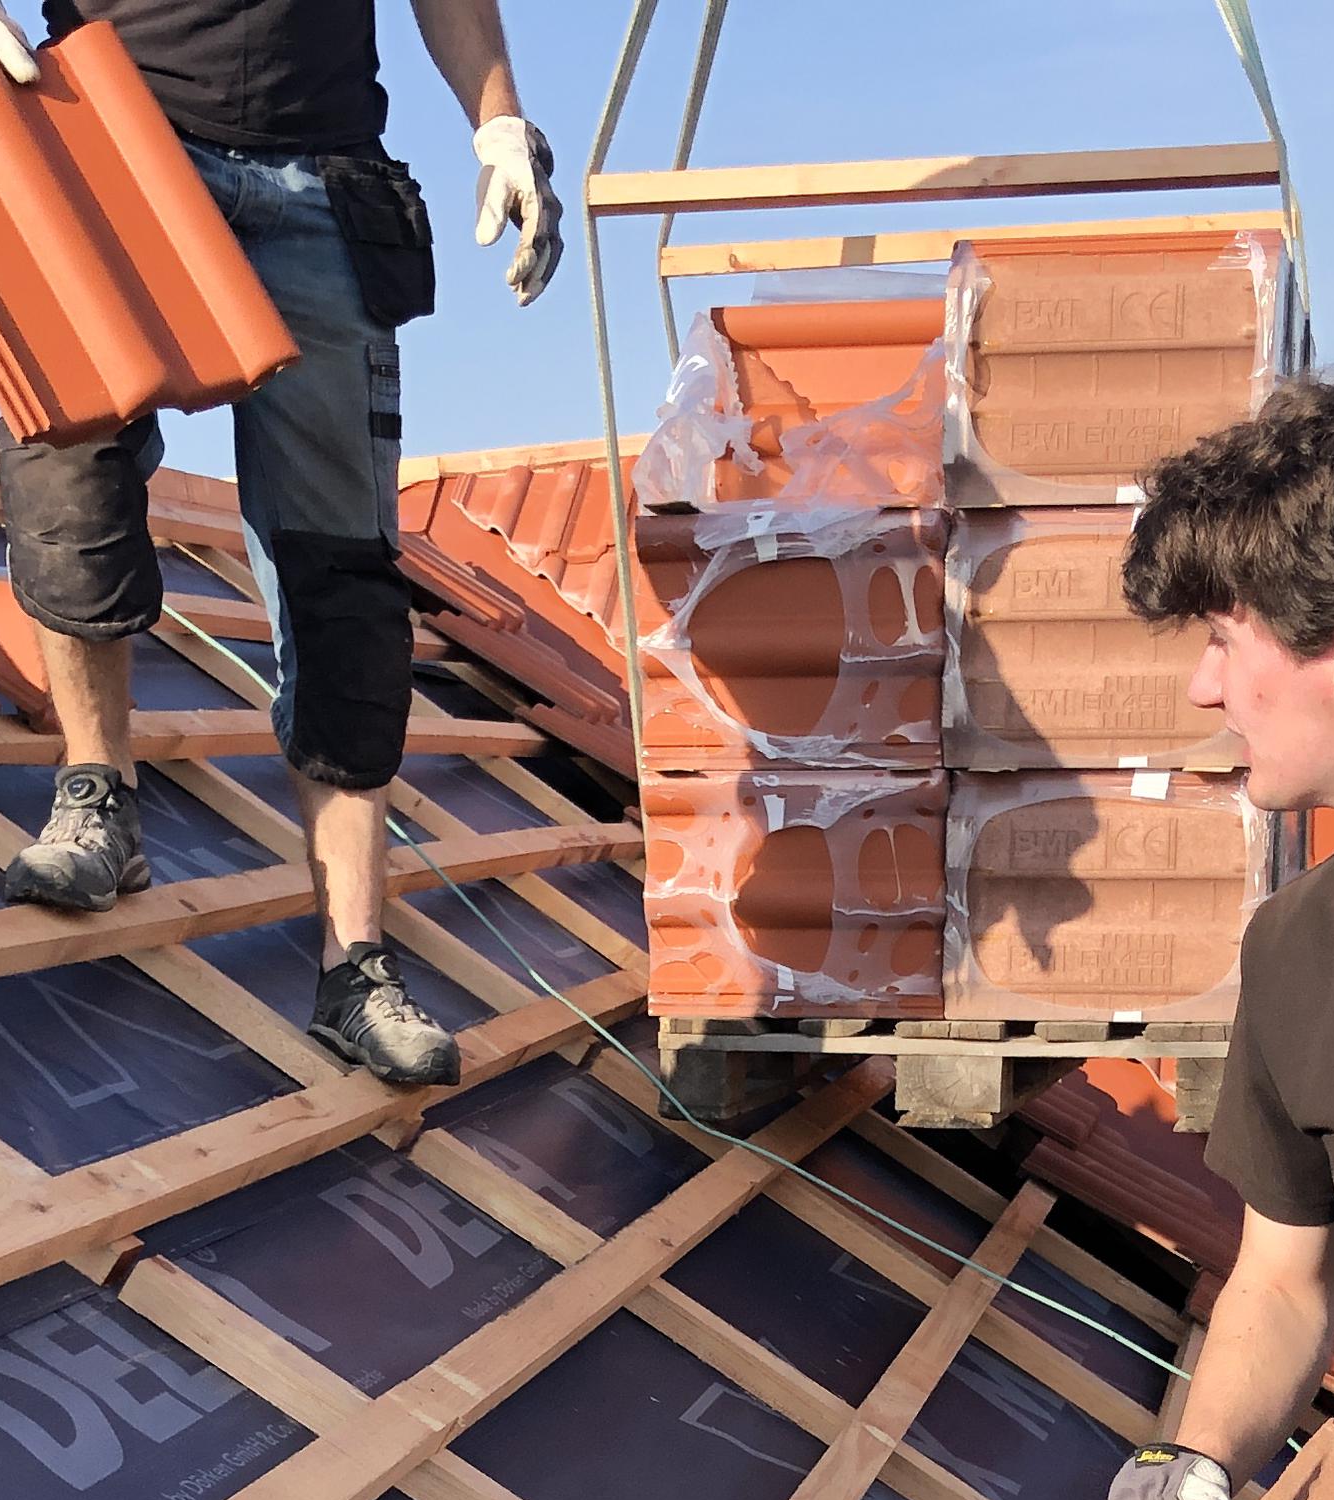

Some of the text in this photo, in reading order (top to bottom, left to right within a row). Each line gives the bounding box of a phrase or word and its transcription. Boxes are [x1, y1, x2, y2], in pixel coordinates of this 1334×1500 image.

[1014, 299, 1079, 330] BMI
[1011, 422, 1076, 451] BMI
[1014, 569, 1078, 598] BMI
[222, 1440, 264, 1467] GmbH
